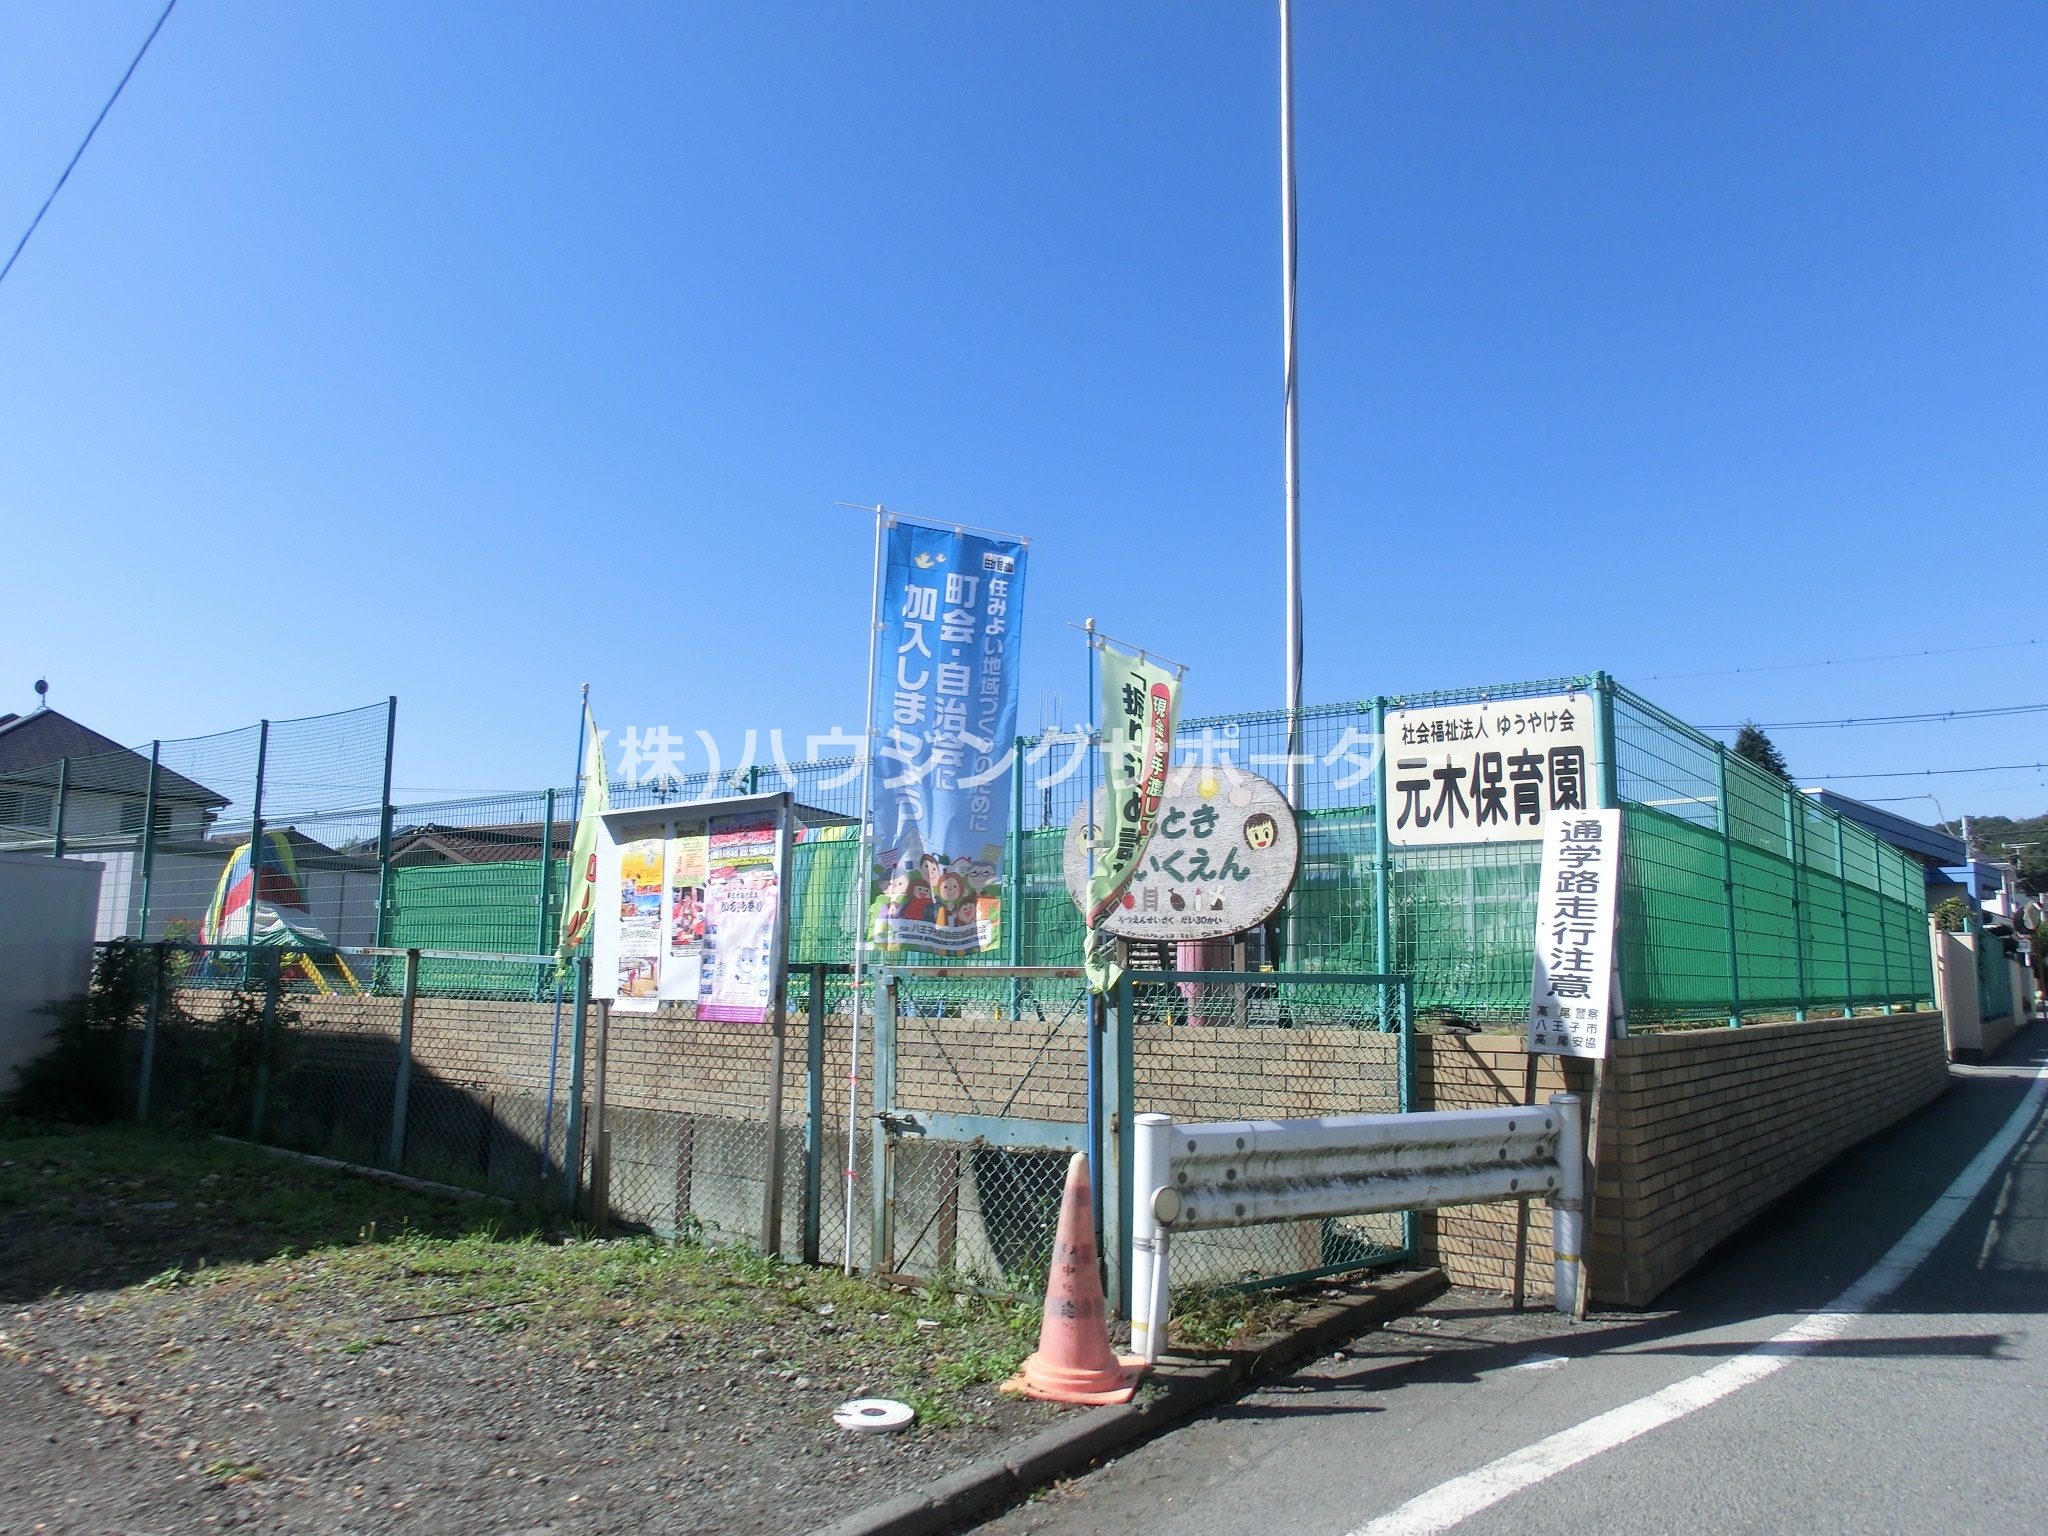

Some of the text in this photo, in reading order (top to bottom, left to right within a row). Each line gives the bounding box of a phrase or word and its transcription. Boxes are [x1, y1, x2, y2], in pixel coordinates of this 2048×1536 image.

[894, 584, 938, 821] 加入しましょう
[931, 573, 980, 791] 町会・自治会に
[969, 577, 1009, 832] 住みよい地域づくりのために
[1401, 708, 1575, 747] 社会福祉法人 ゆうやけ会
[1140, 694, 1168, 848] 現金を手渡しす
[1395, 745, 1587, 830] 元木保育園
[1151, 804, 1219, 839] とき
[1180, 915, 1223, 925] だい30かい
[1546, 819, 1604, 1000] 通学路走行注意
[1534, 1034, 1597, 1049] 高尾安協
[1535, 1019, 1598, 1034] 八王子市
[1537, 1005, 1599, 1020] 高尾警察
